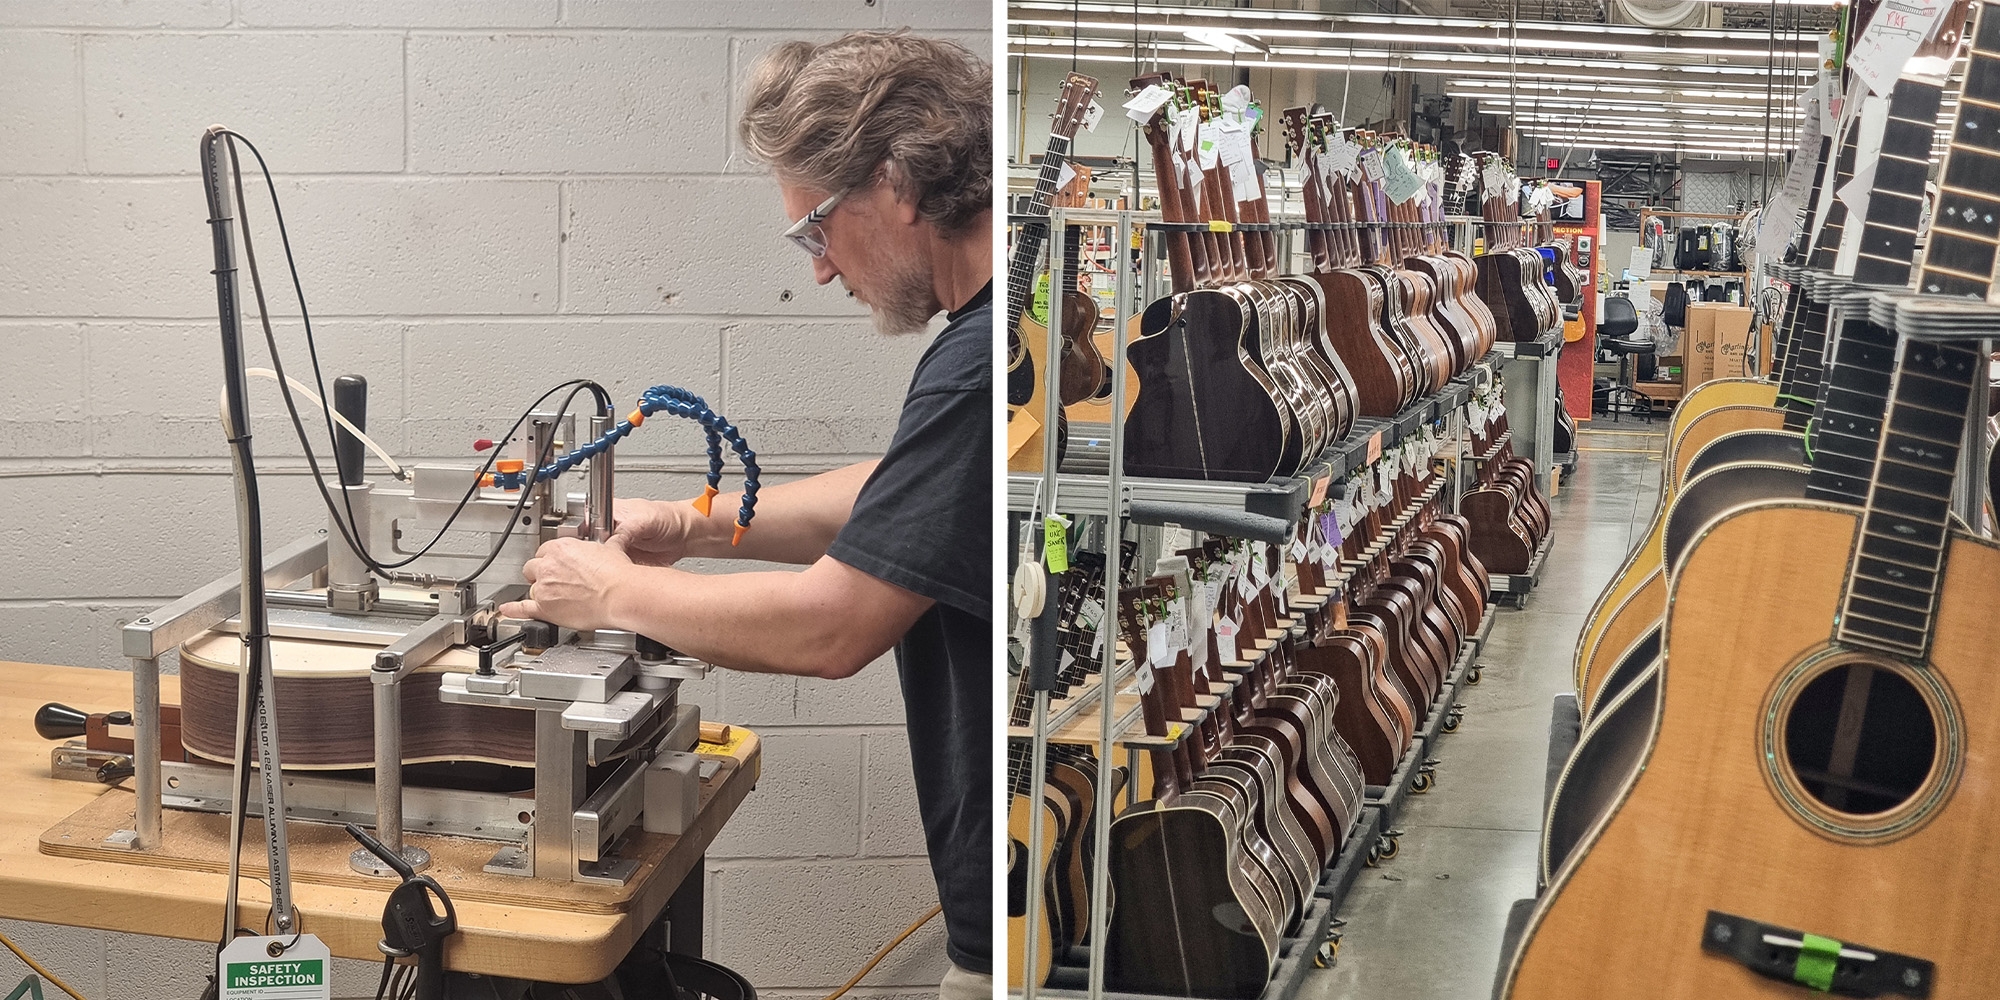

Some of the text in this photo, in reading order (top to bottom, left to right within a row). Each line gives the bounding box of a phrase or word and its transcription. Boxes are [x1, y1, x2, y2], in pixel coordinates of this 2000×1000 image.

[1548, 159, 1558, 168] EXIT
[1553, 226, 1583, 234] PECTION
[261, 731, 269, 747] LOT
[266, 772, 274, 804] KAISER
[268, 806, 278, 856] ALUMINUM
[249, 963, 301, 975] SAFETY
[235, 974, 315, 987] INSPECTION
